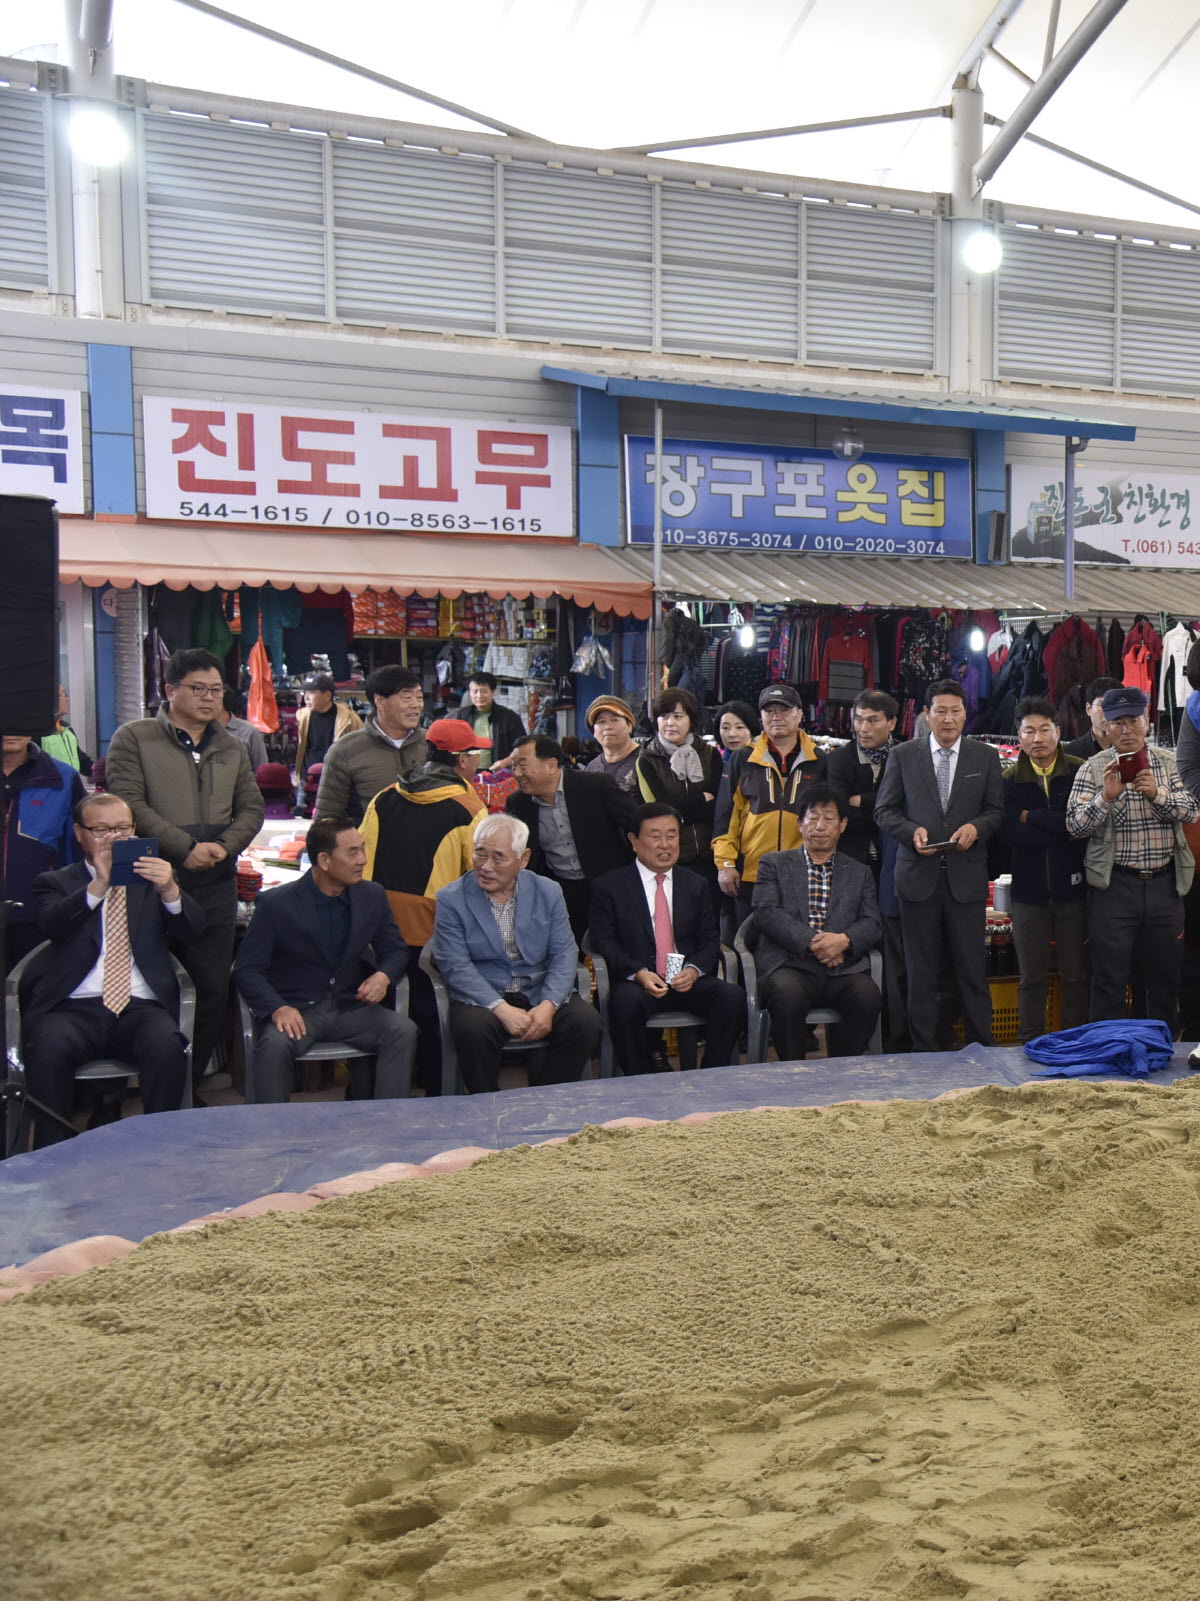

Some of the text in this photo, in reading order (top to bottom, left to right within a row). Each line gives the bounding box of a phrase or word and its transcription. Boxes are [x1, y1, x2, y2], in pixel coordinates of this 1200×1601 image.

[171, 408, 551, 509] 진도고무
[180, 501, 309, 523] 544-1615
[346, 509, 542, 533] 010-8563-1615
[1123, 482, 1191, 530] 친환경
[814, 536, 945, 555] 010-2020-3074
[1122, 539, 1172, 554] T.(061)
